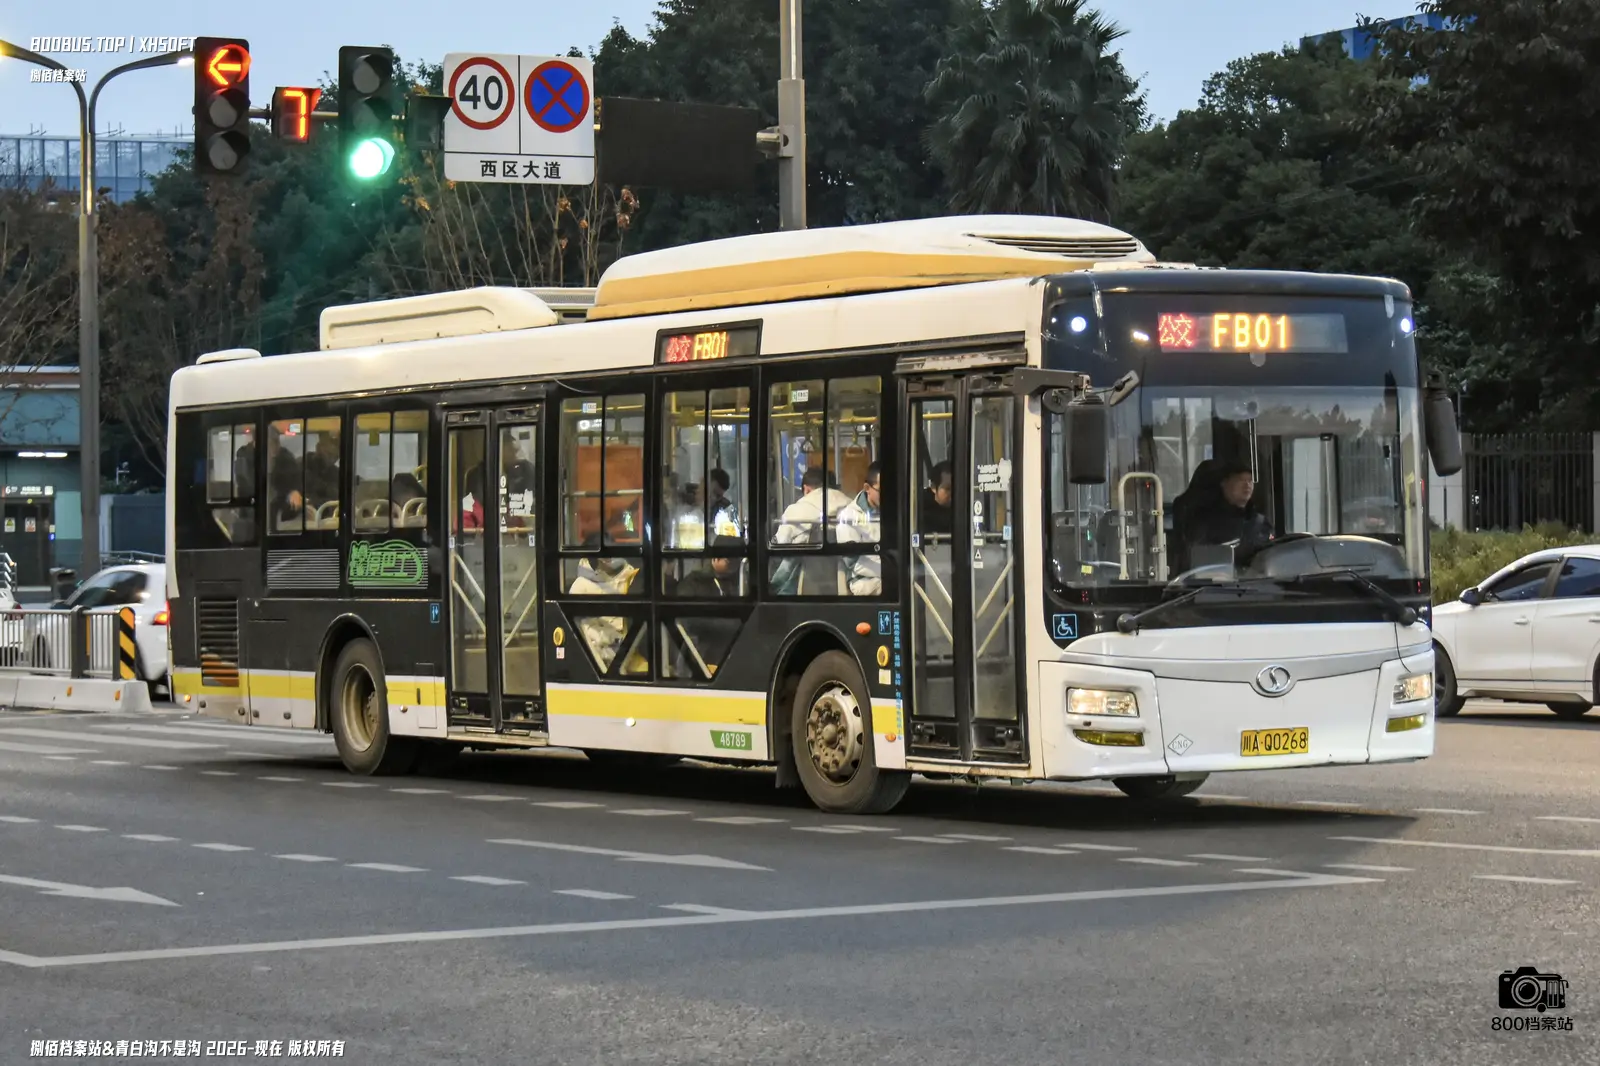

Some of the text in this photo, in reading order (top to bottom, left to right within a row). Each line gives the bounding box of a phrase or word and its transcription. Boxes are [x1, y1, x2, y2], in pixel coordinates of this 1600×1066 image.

[459, 74, 503, 111] 40
[284, 89, 306, 138] 7
[480, 160, 562, 180] 西区大道
[693, 331, 727, 360] FB01
[1213, 314, 1287, 348] FB01
[721, 732, 746, 747] 48789
[1171, 739, 1188, 750] CNG
